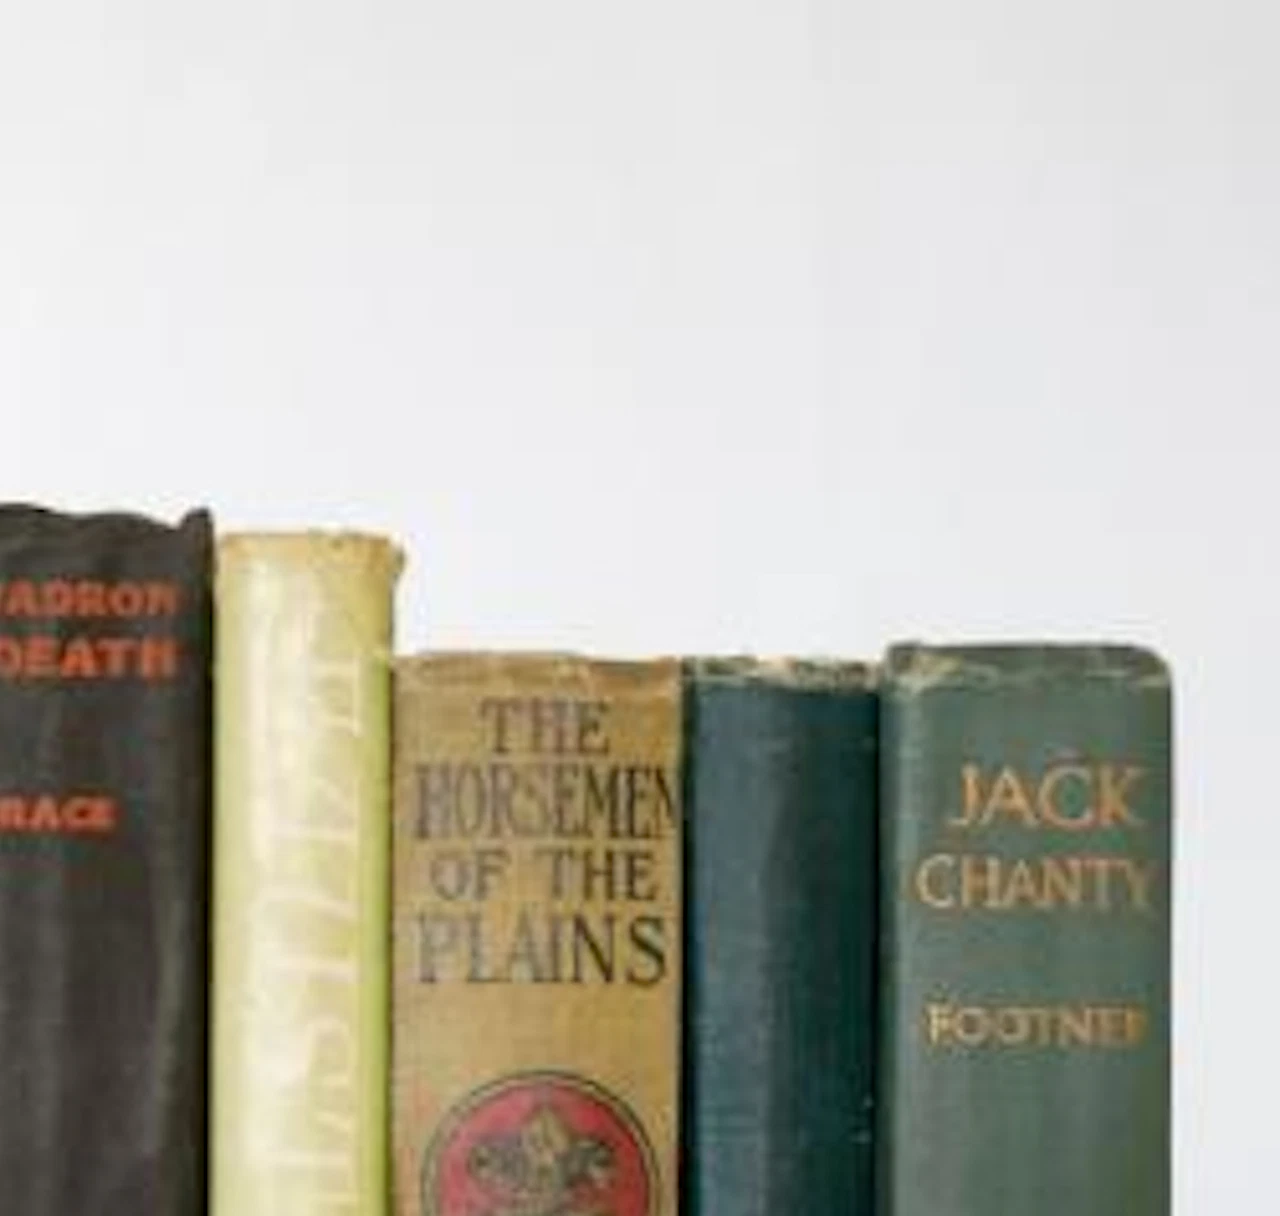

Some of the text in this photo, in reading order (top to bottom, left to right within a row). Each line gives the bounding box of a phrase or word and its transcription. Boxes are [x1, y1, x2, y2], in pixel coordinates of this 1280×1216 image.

[481, 699, 610, 755] THE
[414, 763, 676, 839] HORSEMEN
[948, 763, 1147, 828] JACK
[429, 847, 657, 900] OF THE
[916, 853, 1156, 911] CHANTY
[419, 911, 667, 988] PLAINS
[926, 1003, 1147, 1047] FOOTNER
